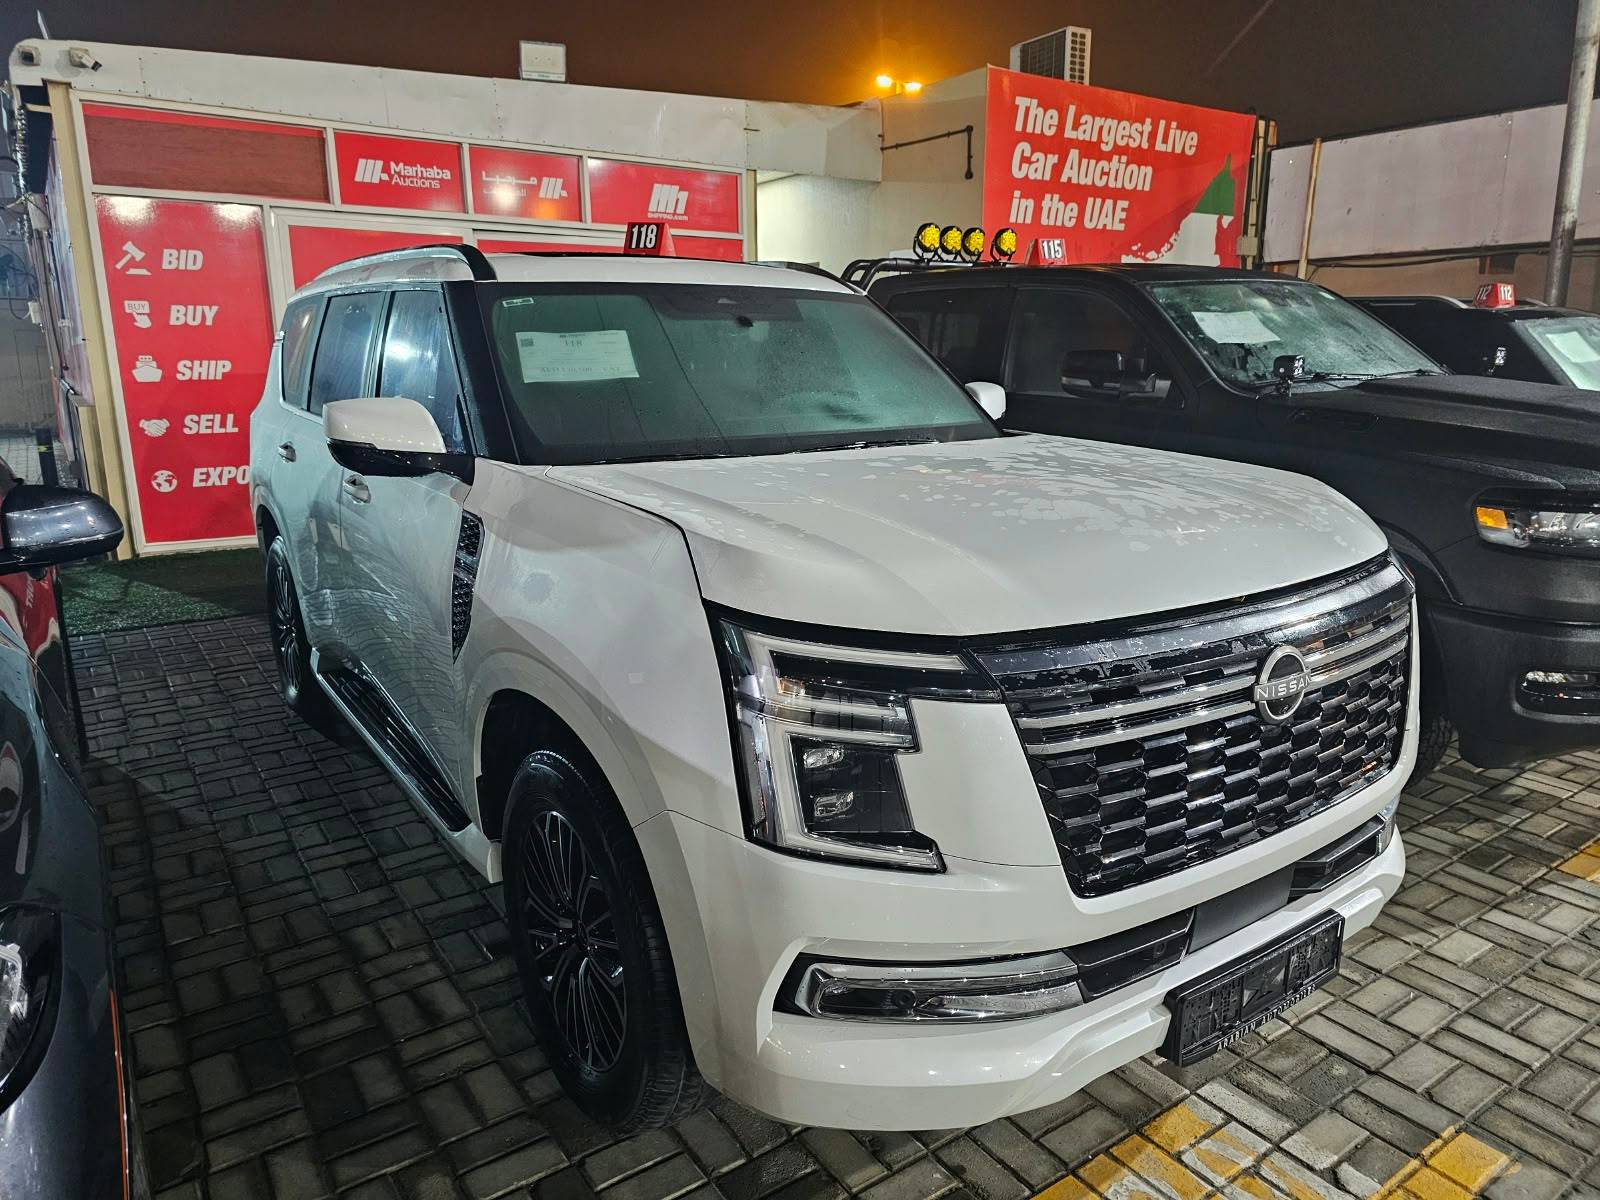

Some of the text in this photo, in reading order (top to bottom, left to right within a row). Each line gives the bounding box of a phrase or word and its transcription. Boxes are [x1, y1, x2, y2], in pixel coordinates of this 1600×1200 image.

[1015, 96, 1198, 155] The Largest Live
[390, 161, 451, 180] Marhaba
[1011, 142, 1153, 190] Car Auction
[392, 175, 441, 188] Auctions
[1009, 191, 1129, 231] in the UAE
[631, 224, 657, 249] 118
[161, 248, 204, 271] BID
[1042, 239, 1062, 260] 115
[1500, 285, 1512, 301] 112
[169, 304, 219, 326] BUY
[176, 359, 232, 381] SHIP
[182, 413, 239, 435] SELL
[1256, 674, 1311, 700] NISSAN
[1216, 1020, 1257, 1052] ARABIAN
